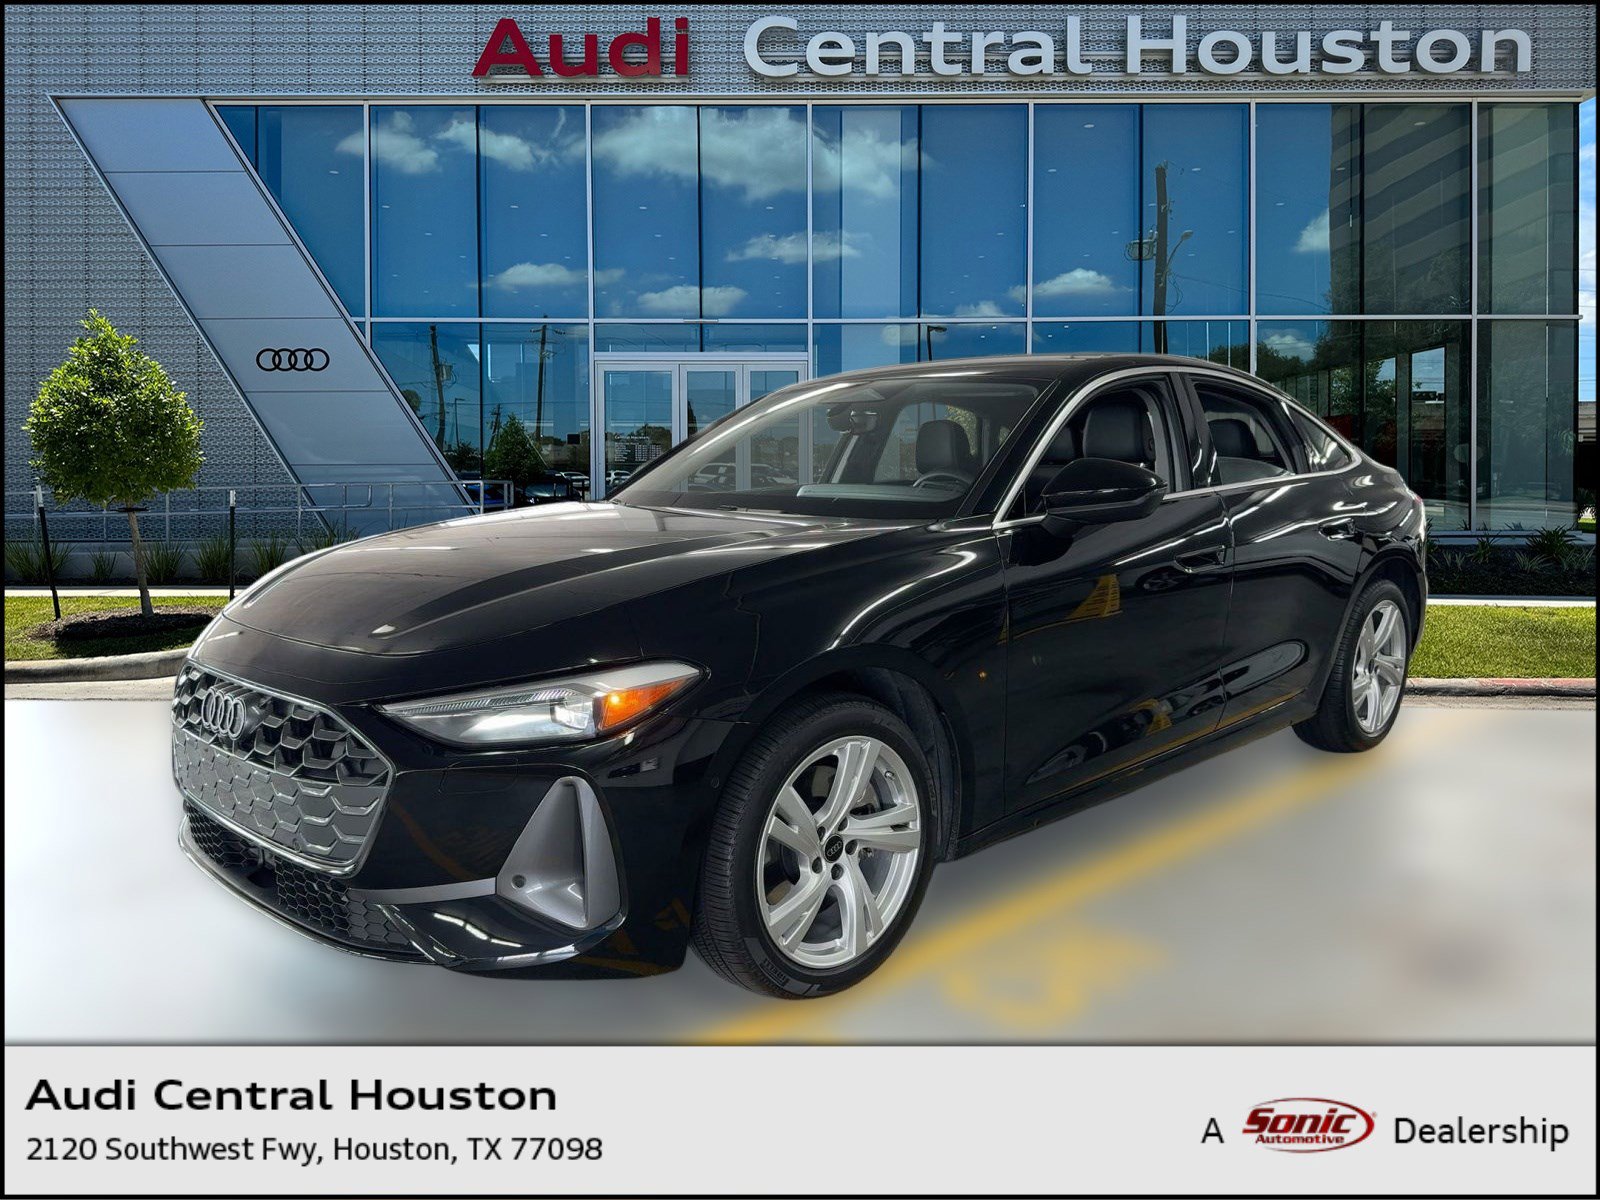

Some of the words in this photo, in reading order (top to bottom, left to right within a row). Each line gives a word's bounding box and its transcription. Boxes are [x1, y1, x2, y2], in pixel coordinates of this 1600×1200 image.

[472, 16, 690, 78] Audi
[743, 15, 1094, 78] Central
[1125, 14, 1533, 76] Houston
